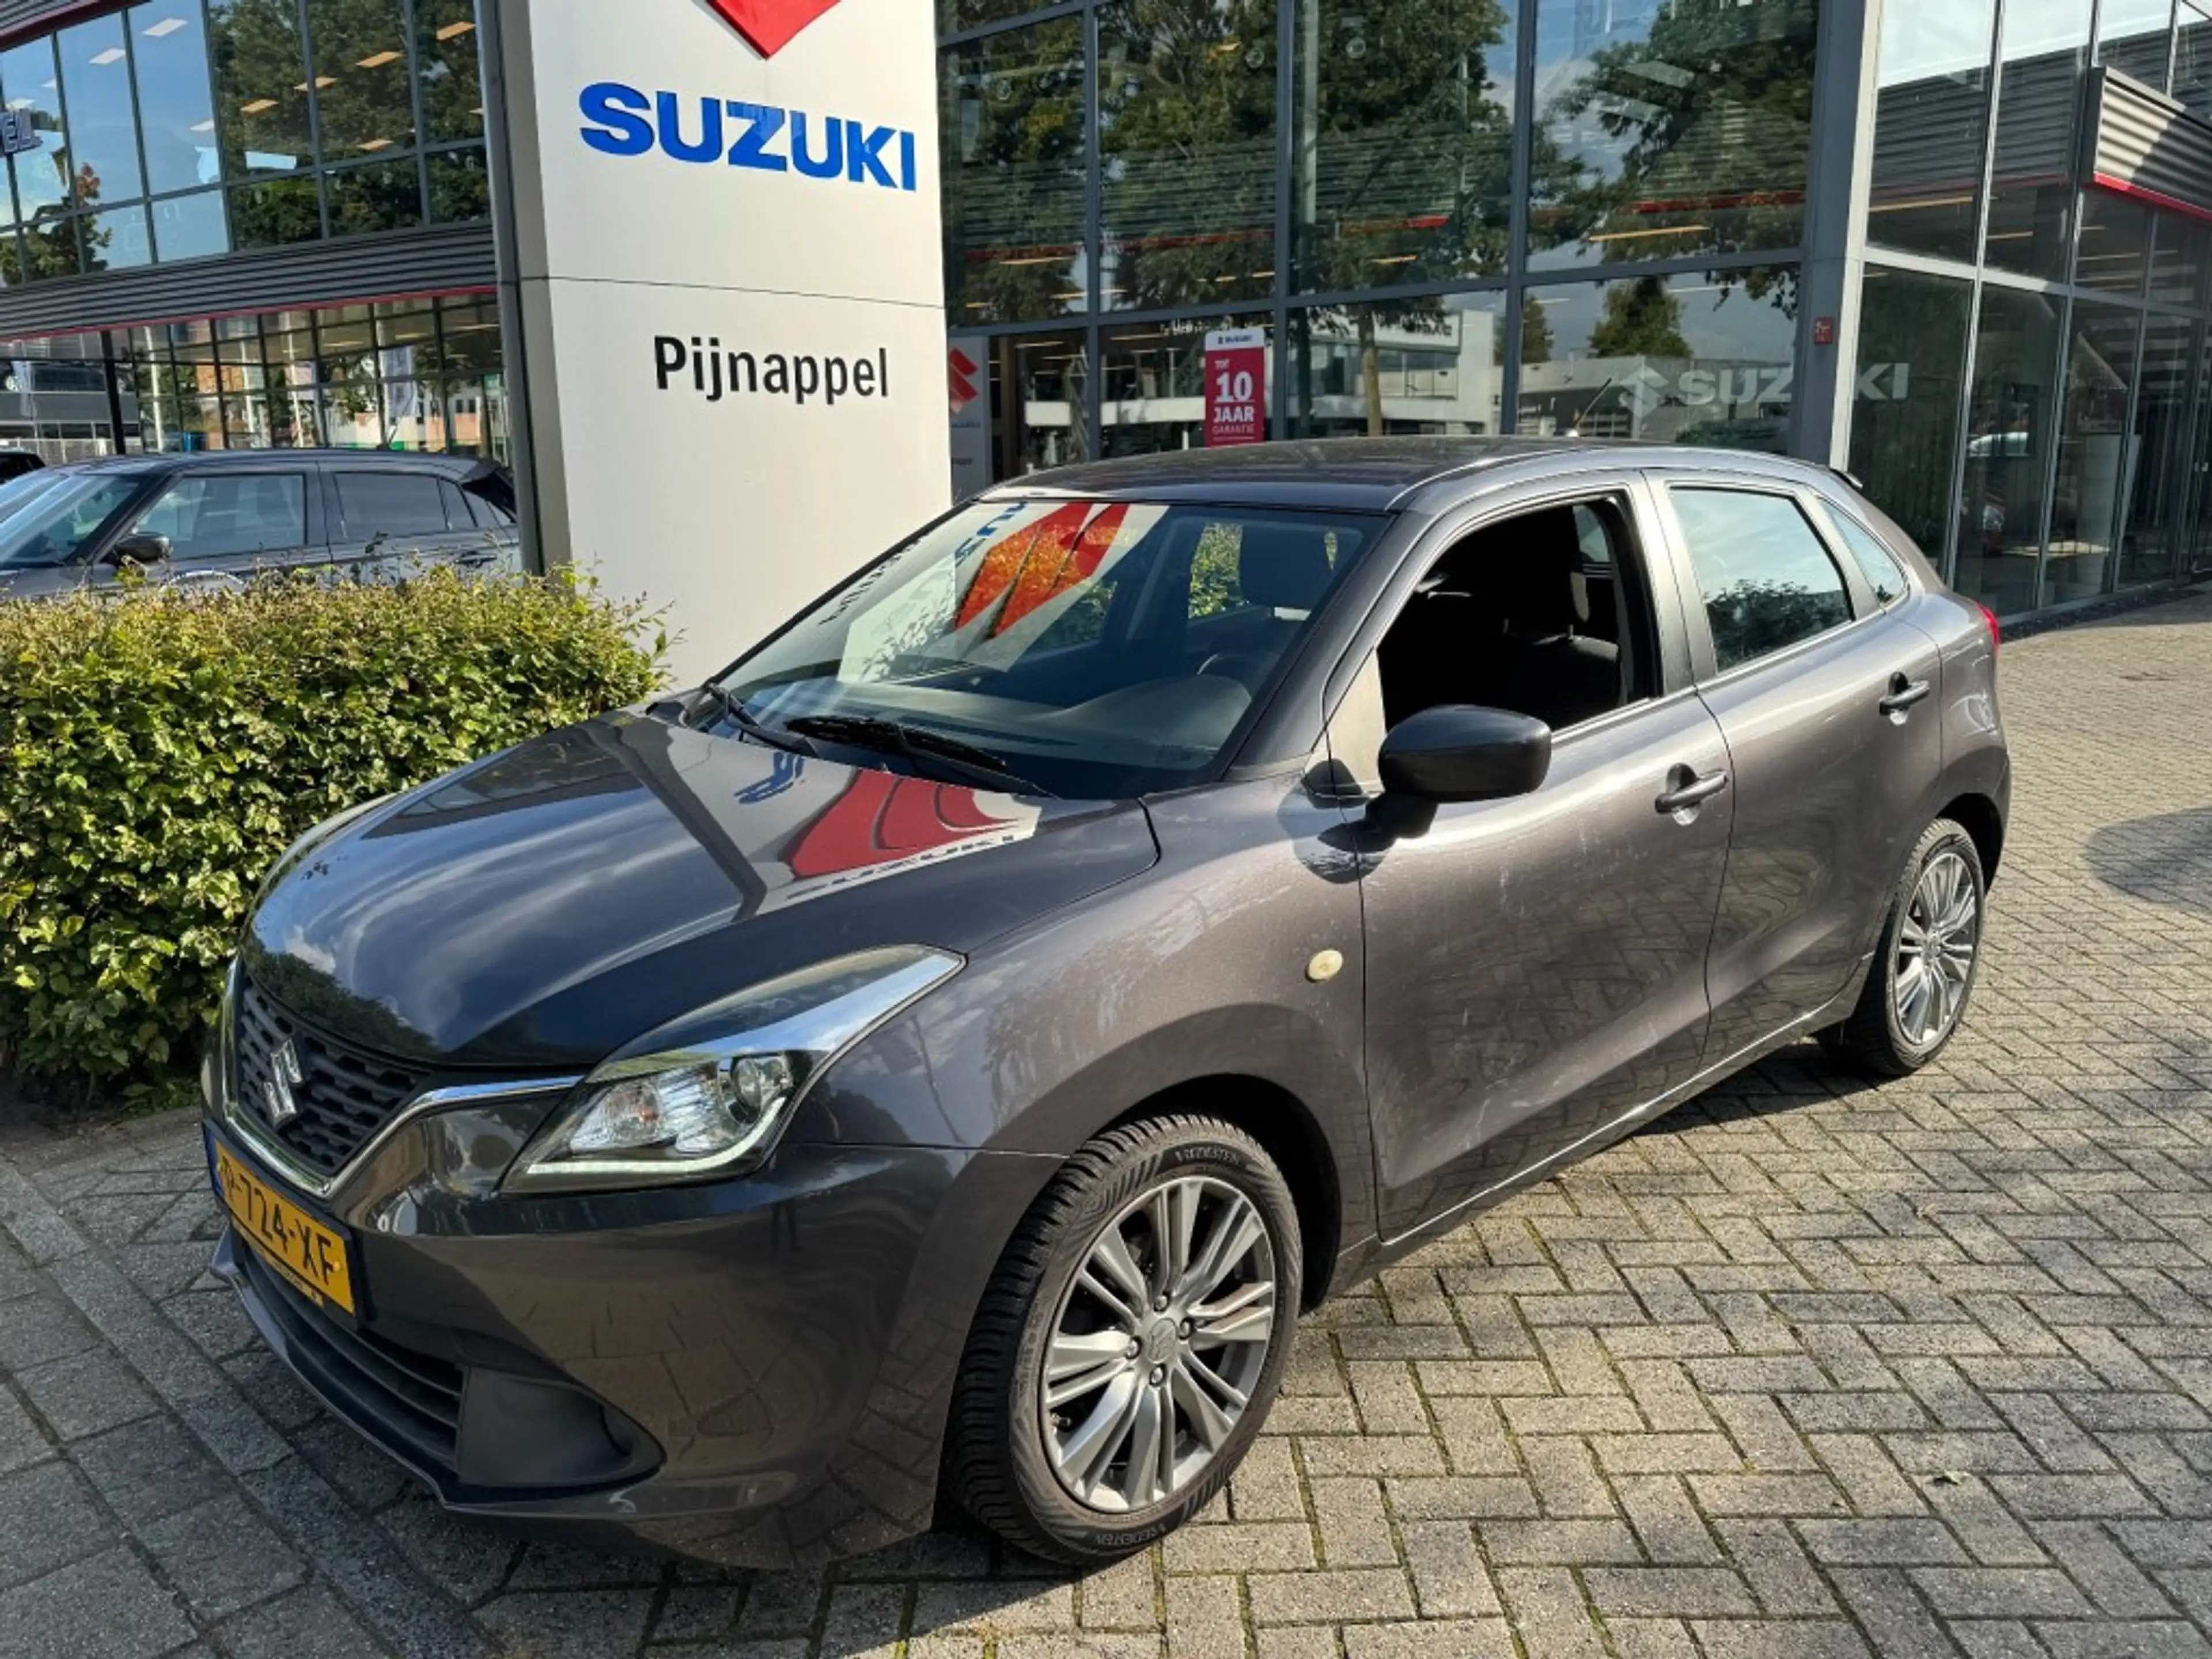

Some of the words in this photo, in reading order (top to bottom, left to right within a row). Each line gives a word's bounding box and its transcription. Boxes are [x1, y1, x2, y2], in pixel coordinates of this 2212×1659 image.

[578, 82, 916, 192] SUZUKI
[654, 335, 888, 405] Pijnappel
[1215, 371, 1253, 403] 10
[1678, 362, 1910, 405] SUZKI
[1213, 406, 1255, 423] JAAR
